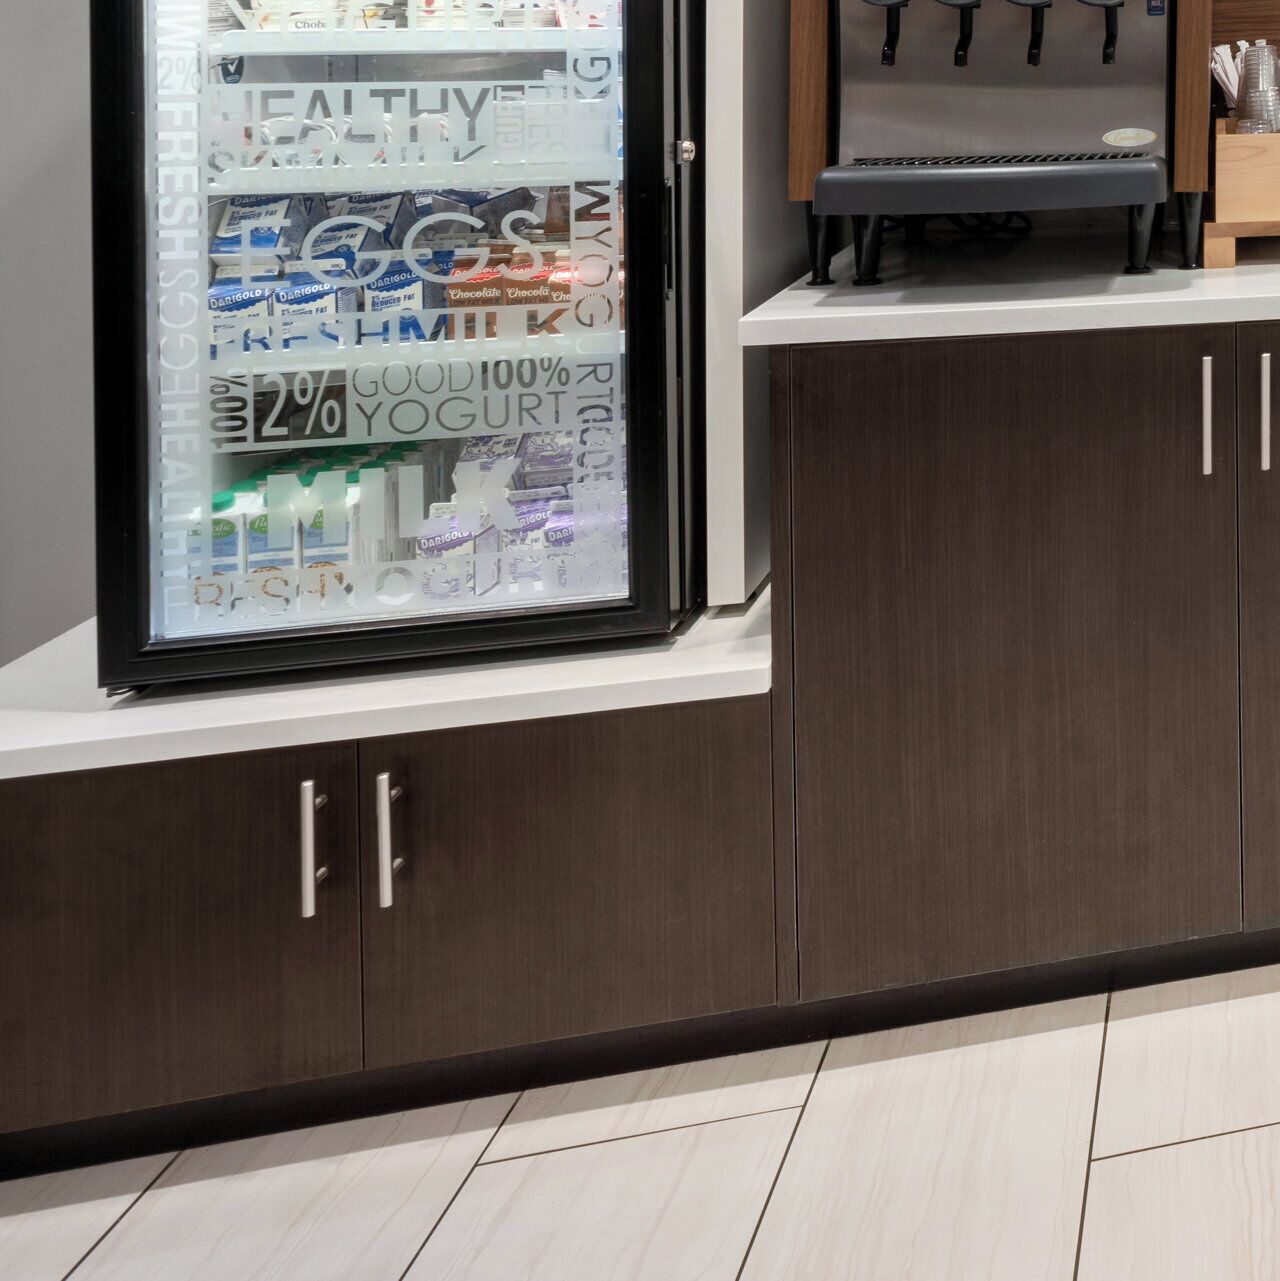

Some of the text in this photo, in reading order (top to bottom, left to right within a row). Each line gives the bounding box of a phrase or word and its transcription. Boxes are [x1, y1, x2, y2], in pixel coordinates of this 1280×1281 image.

[213, 86, 490, 146] HEALTHY
[157, 102, 200, 260] FRESH
[241, 209, 543, 288] EGGS
[370, 270, 418, 289] DARIGOLD
[210, 288, 262, 309] DARIGOLD
[279, 283, 331, 302] DARIGOLD
[371, 297, 401, 308] REDUCED
[403, 293, 416, 302] FAT
[449, 287, 502, 300] Chocolate
[315, 306, 328, 315] FAT
[260, 370, 341, 437] 2%
[353, 359, 474, 398] GOOD
[481, 355, 570, 392] 100%
[354, 390, 567, 437] YOGURT
[421, 531, 470, 550] DARIGOLD
